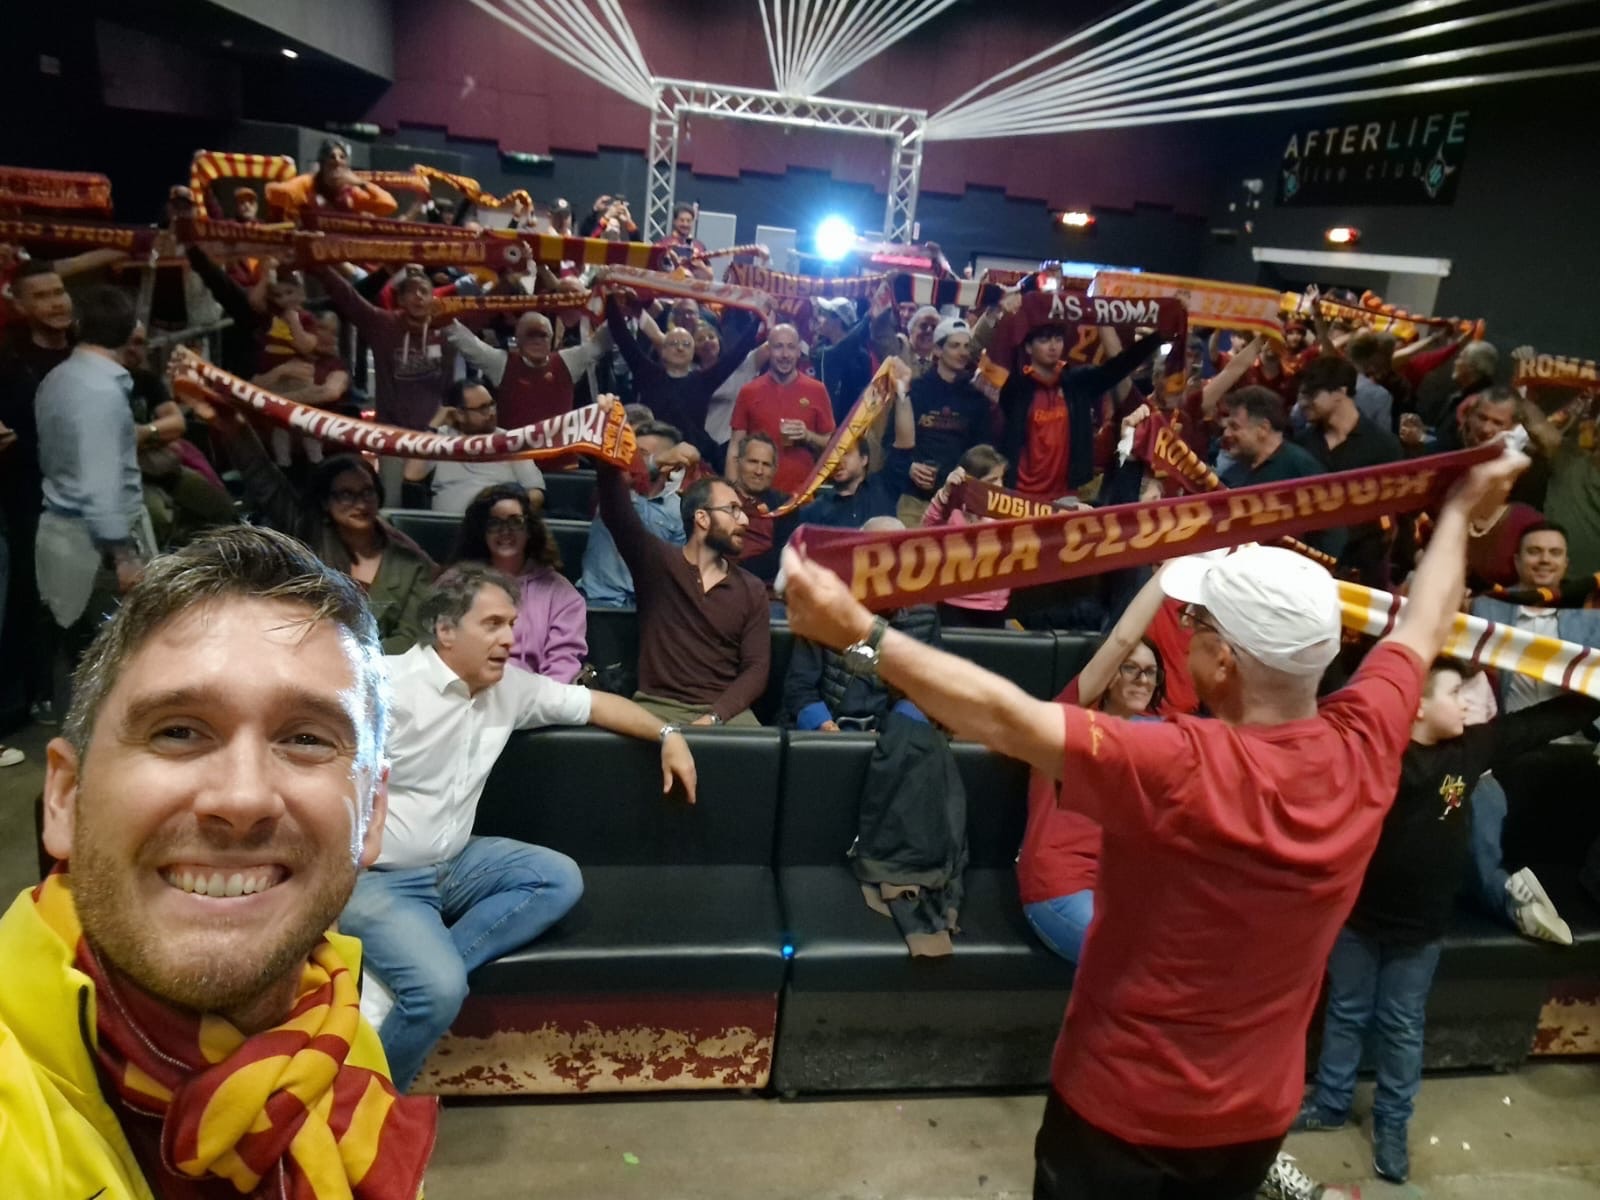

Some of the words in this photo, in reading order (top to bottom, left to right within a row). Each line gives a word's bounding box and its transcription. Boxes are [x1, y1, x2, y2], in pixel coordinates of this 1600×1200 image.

[1284, 111, 1470, 159] AFTERLIFE
[1048, 294, 1083, 322] AS
[1094, 299, 1161, 325] ROMA
[1519, 352, 1597, 382] ROMA
[289, 405, 388, 450] MORTE
[395, 432, 460, 455] NON
[851, 522, 1040, 601] ROMA
[1057, 500, 1215, 565] CLUB
